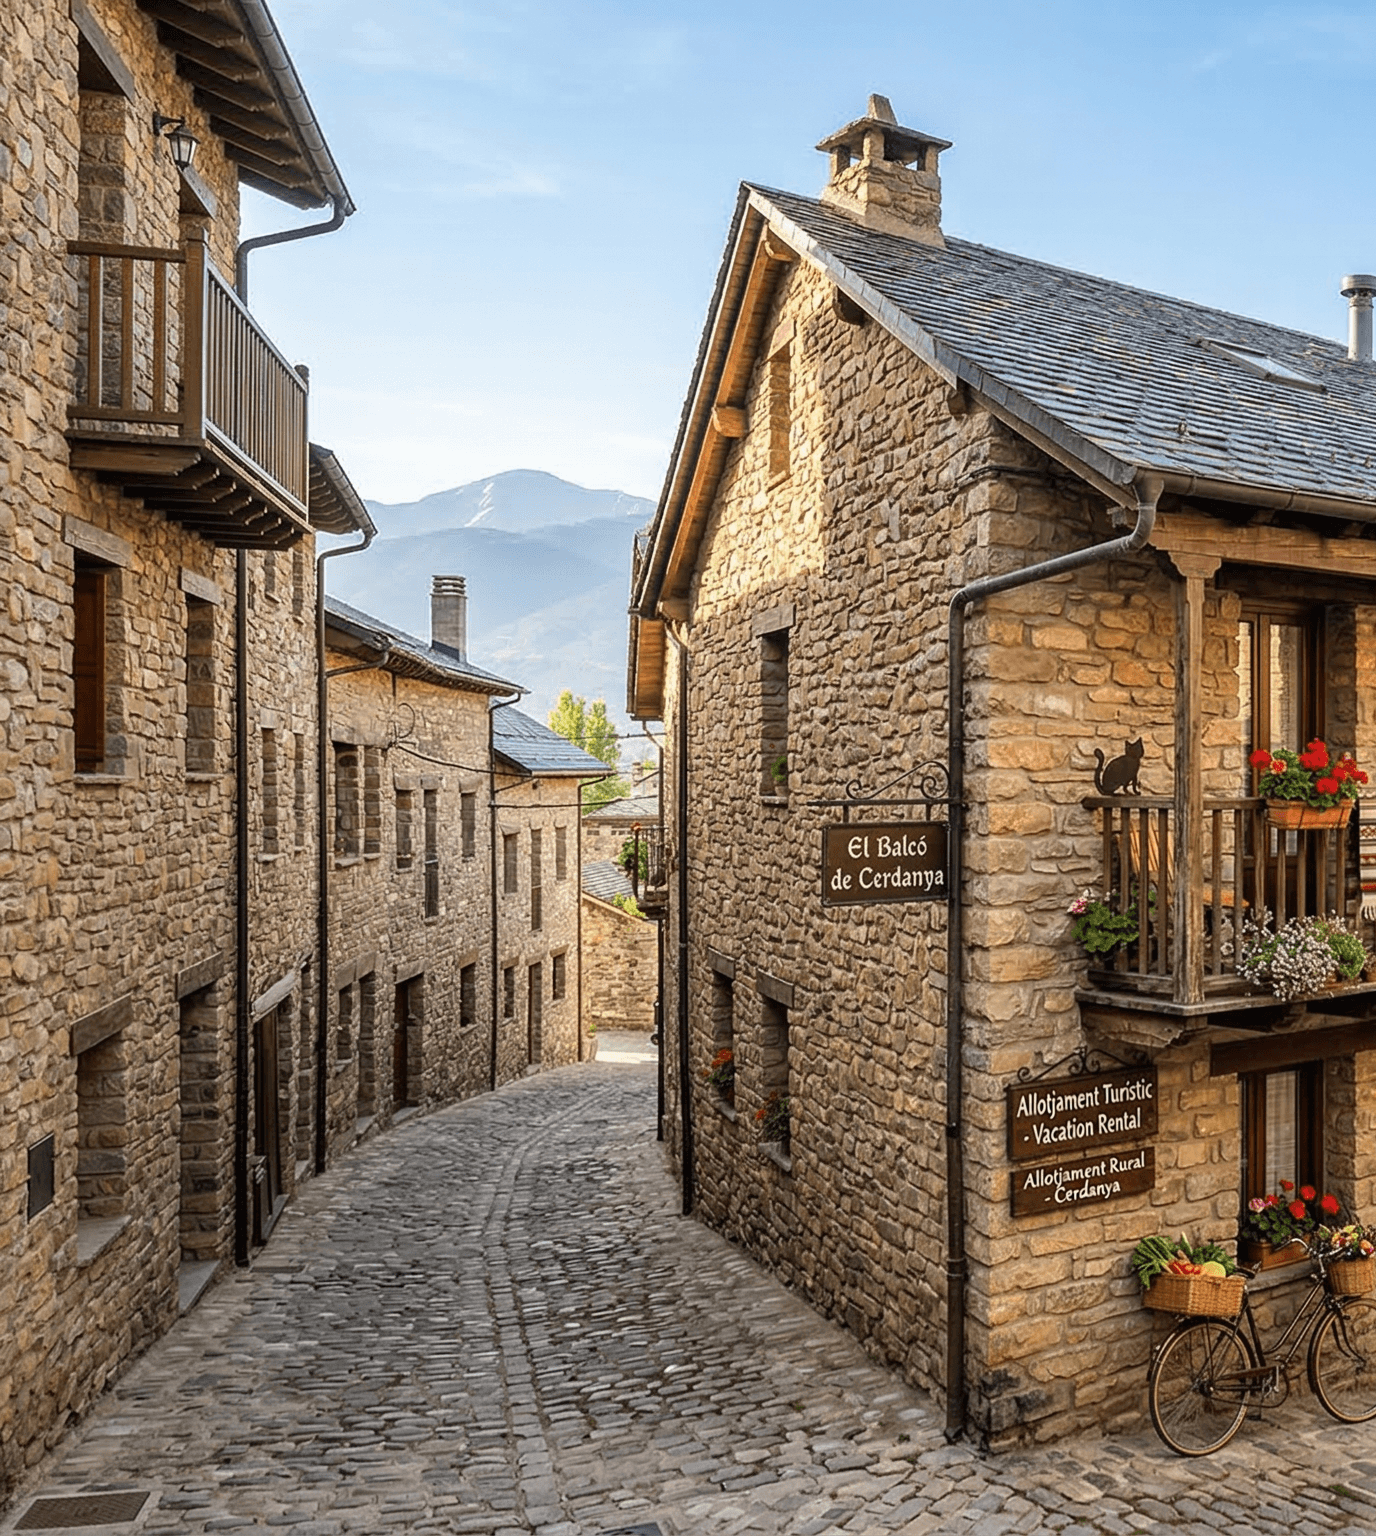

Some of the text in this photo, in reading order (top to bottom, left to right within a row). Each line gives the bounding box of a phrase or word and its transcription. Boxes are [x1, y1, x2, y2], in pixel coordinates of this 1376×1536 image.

[848, 834, 928, 858] El Balcó
[830, 866, 944, 891] de Cerdanya
[1016, 1078, 1153, 1119] Allotjament Turístic
[1032, 1117, 1094, 1145] Vacation
[1098, 1107, 1141, 1134] Rental
[1023, 1151, 1145, 1190] Allotjament Rural
[1054, 1179, 1121, 1203] Cerdanya
